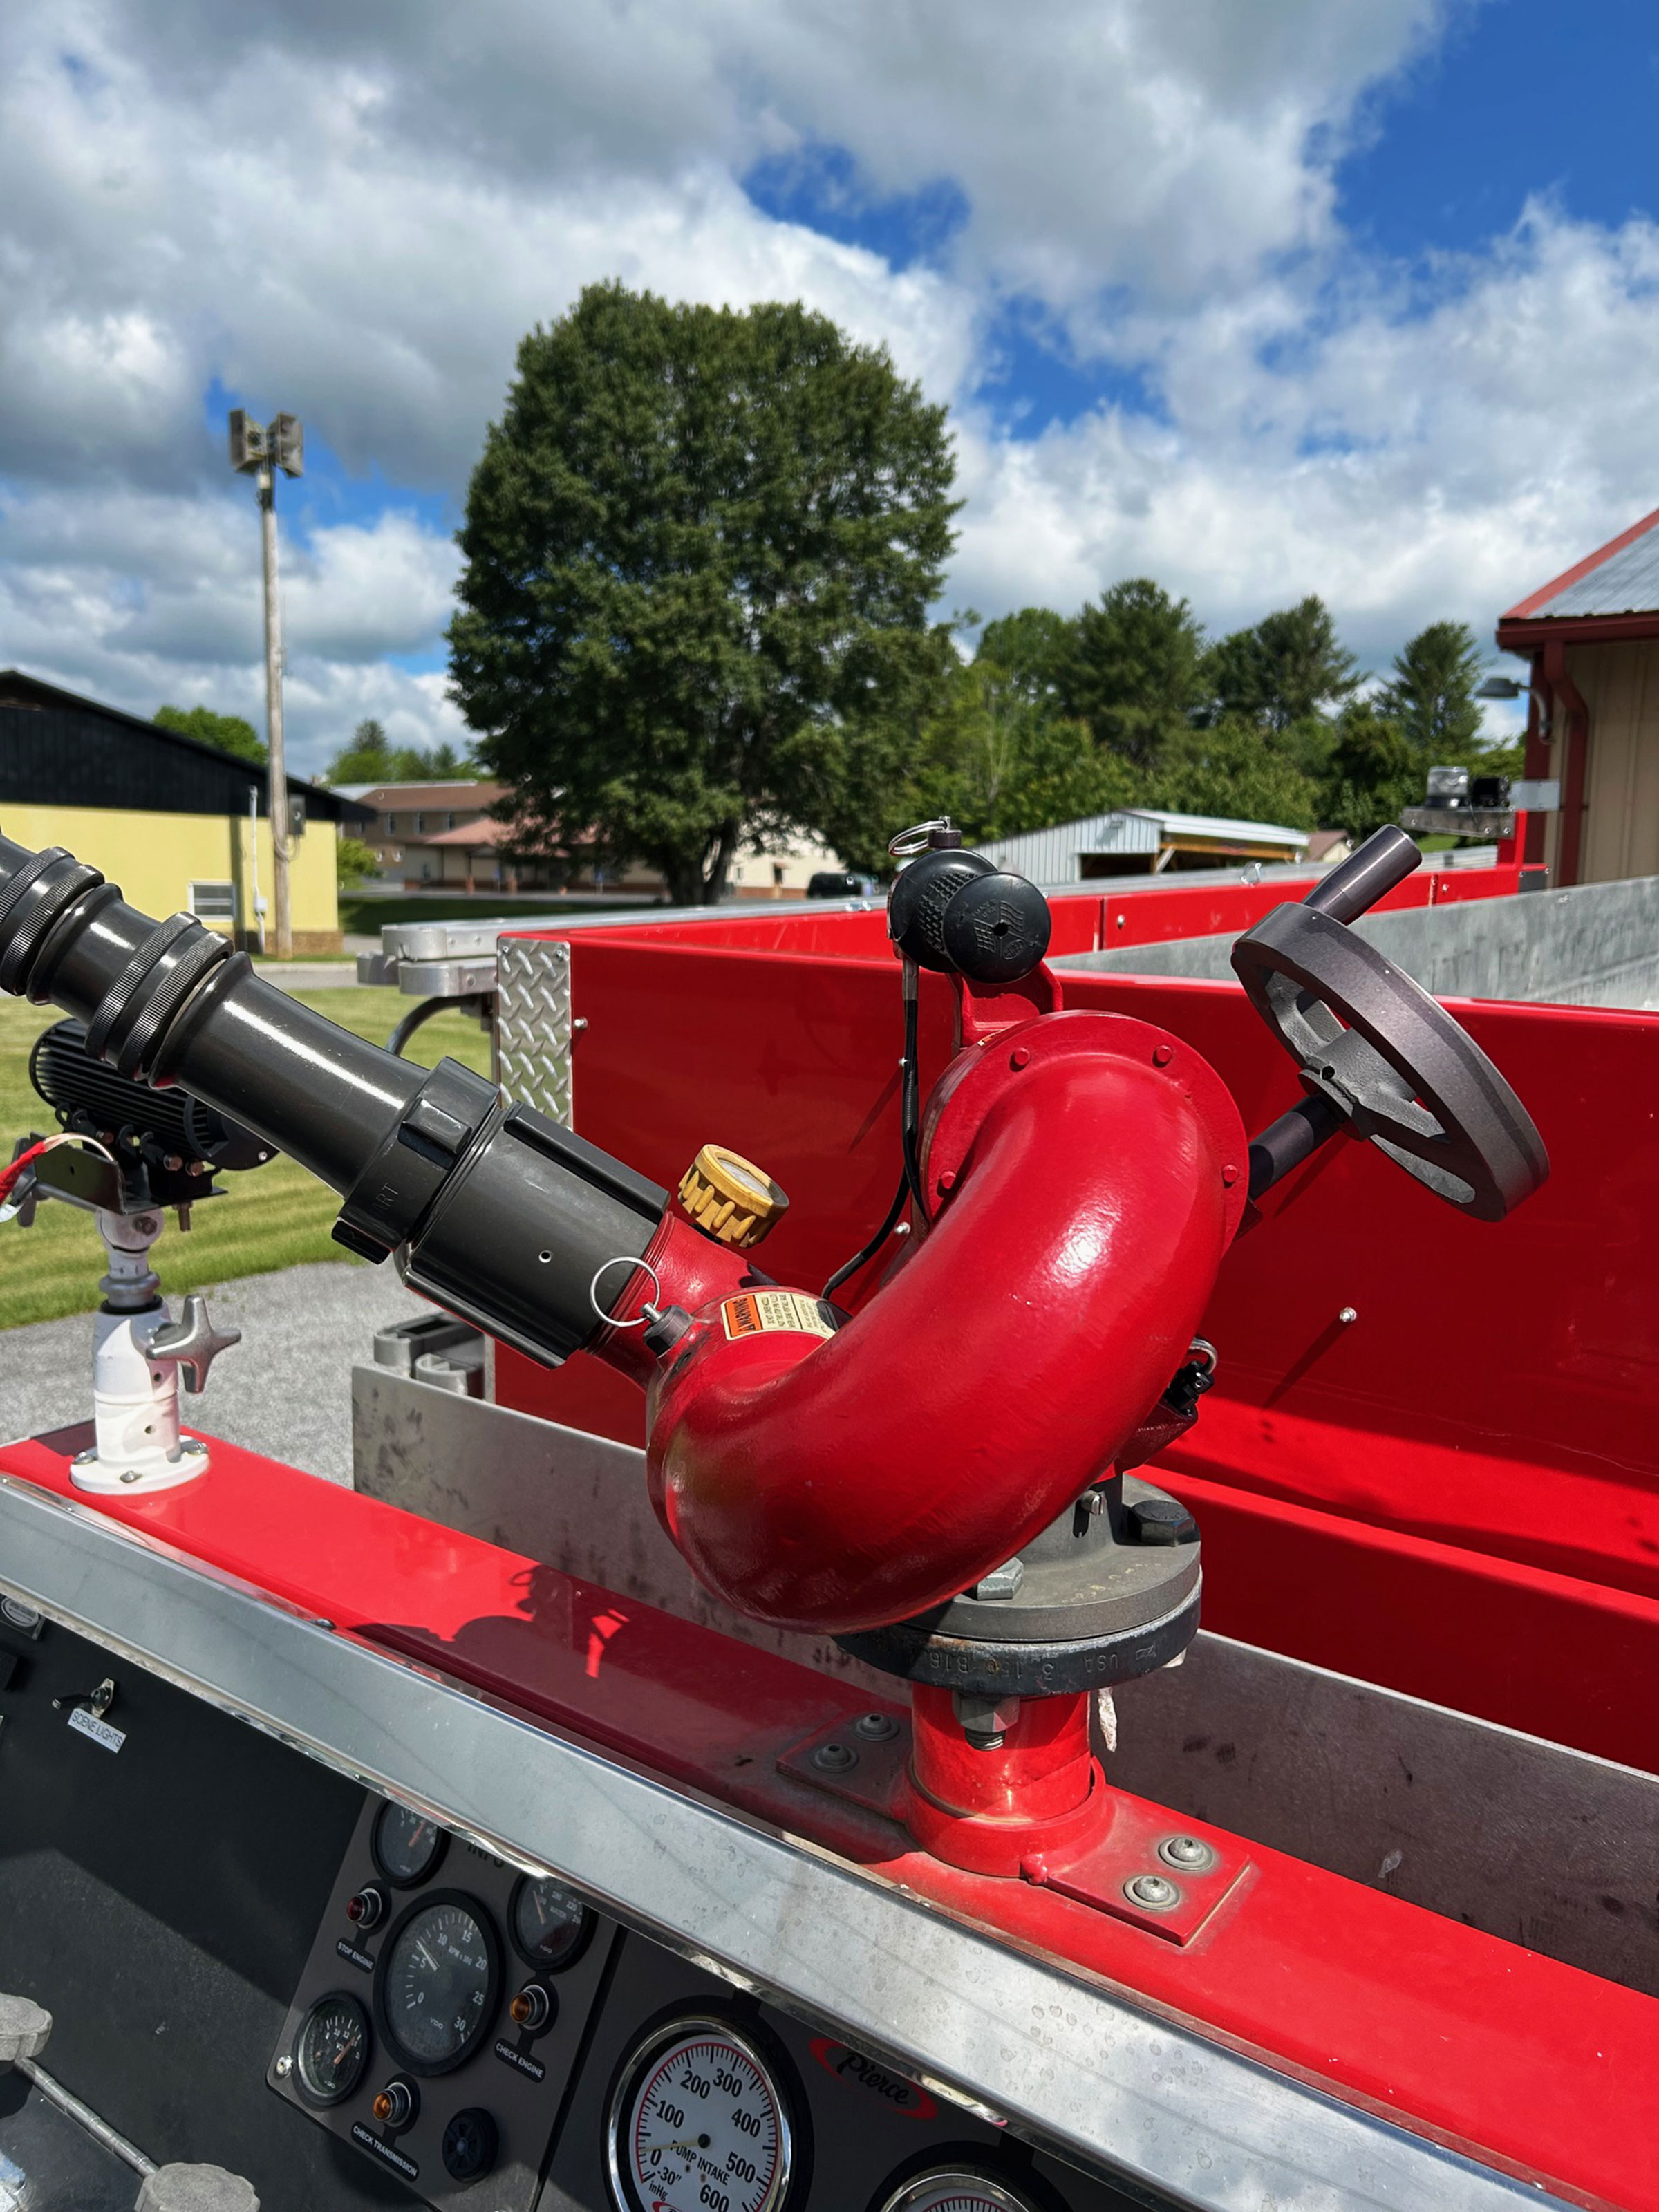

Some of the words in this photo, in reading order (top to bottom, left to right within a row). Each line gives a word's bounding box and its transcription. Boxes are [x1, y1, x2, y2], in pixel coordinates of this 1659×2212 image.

[733, 1297, 753, 1326] WARNING
[1042, 1663, 1053, 1680] 3
[1083, 1654, 1118, 1673] USA
[72, 1710, 97, 1733] SCENE
[95, 1725, 123, 1747] LIGHTS
[438, 1933, 447, 1946] 10
[462, 1930, 473, 1943] 15
[338, 1942, 353, 1955] STOP
[352, 1951, 373, 1969] ENGINE
[420, 1958, 427, 1969] 5
[476, 1956, 487, 1970] 20
[418, 1992, 424, 2003] 0
[473, 1991, 485, 2005] 25
[429, 2017, 443, 2030] VDO
[454, 2016, 466, 2031] 30
[496, 2043, 518, 2062] CHECK
[518, 2056, 543, 2079] ENGINE
[680, 2070, 711, 2099] 200
[713, 2068, 742, 2098] 300
[836, 2052, 909, 2104] Pierce
[657, 2100, 684, 2128] 100
[731, 2108, 760, 2137] 400
[353, 2126, 374, 2145] CHECK
[373, 2139, 418, 2177] TRANSMISSION
[650, 2148, 662, 2166] 0
[697, 2157, 730, 2186] INTAKE
[726, 2151, 756, 2183] 500
[648, 2180, 668, 2202] inHg
[700, 2184, 729, 2212] 600
